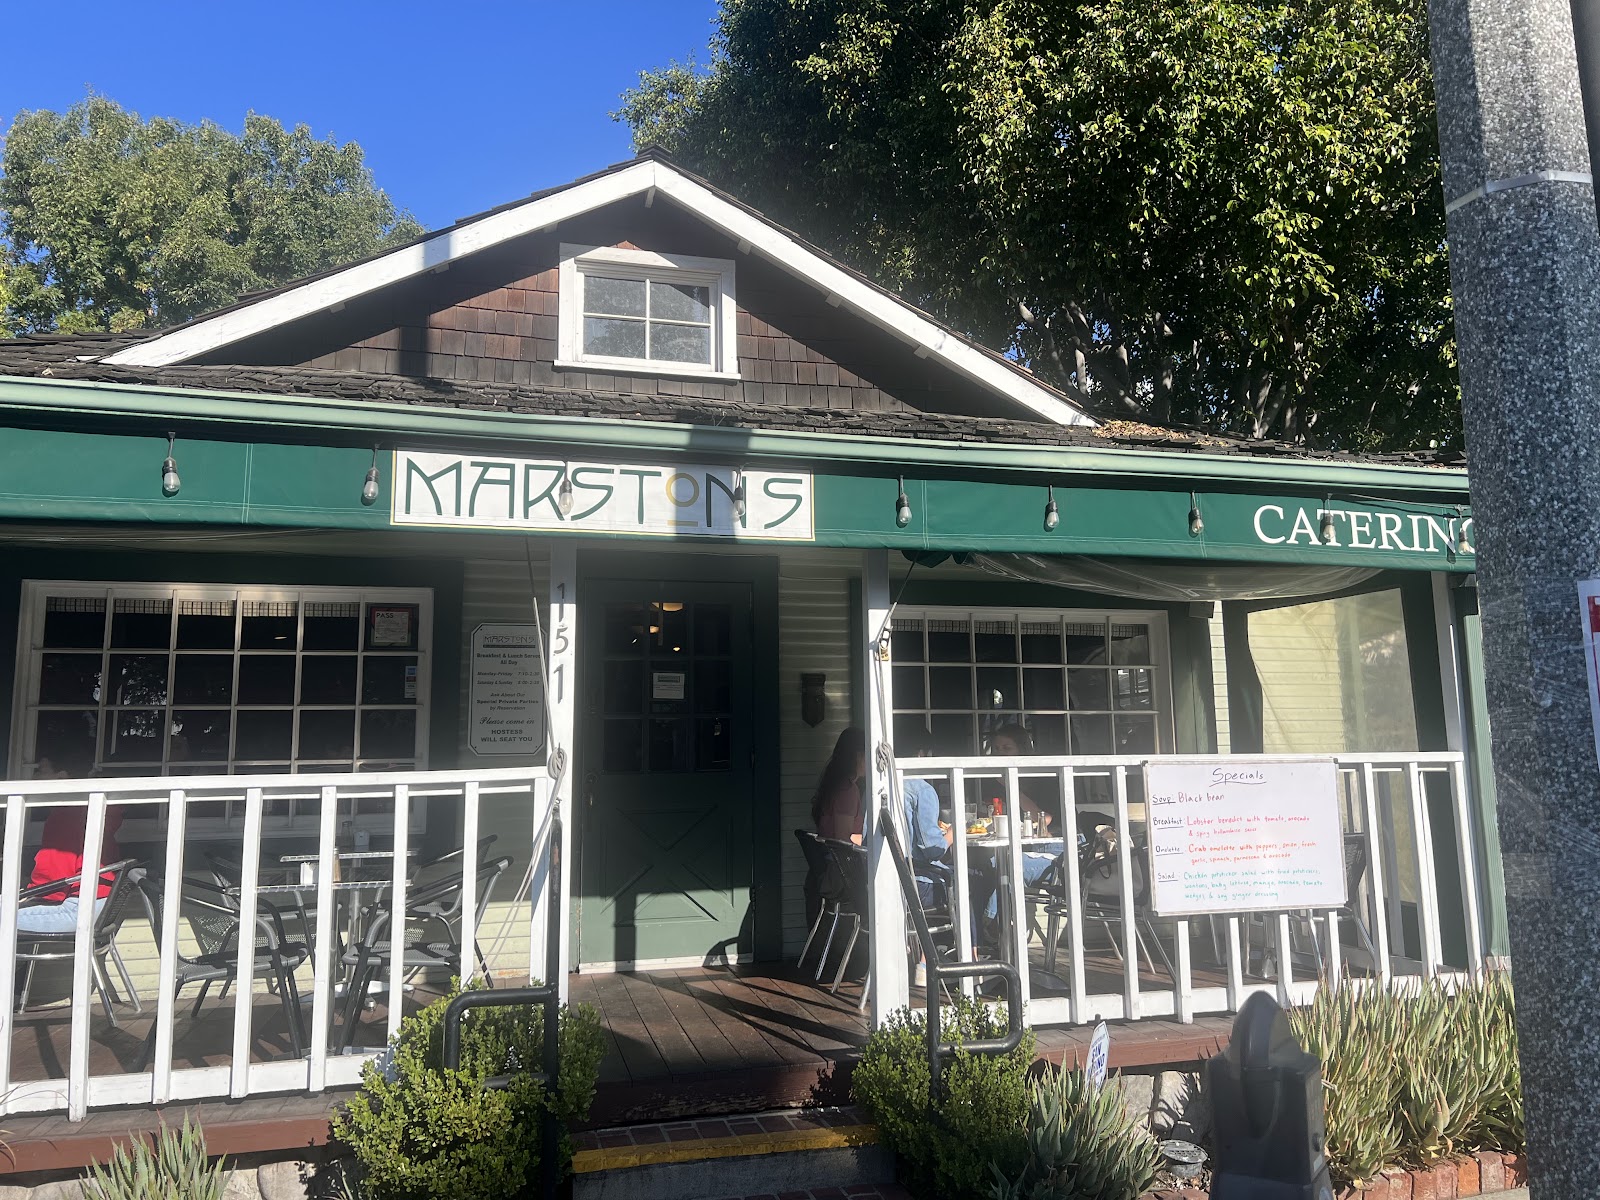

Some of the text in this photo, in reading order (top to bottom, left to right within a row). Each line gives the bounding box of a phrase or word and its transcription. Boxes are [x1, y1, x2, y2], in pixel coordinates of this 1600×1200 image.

[405, 457, 803, 529] MARSTONS
[480, 717, 504, 725] Please
[1212, 768, 1264, 786] Specials
[1178, 791, 1203, 803] Black
[1206, 792, 1225, 802] bean
[1186, 815, 1213, 826] Lobster
[1217, 815, 1243, 823] benedict
[1246, 815, 1260, 823] with
[1188, 843, 1207, 853] Crab
[1209, 844, 1235, 852] omelette
[1239, 843, 1253, 851] with
[1183, 871, 1207, 880] Chicken
[1211, 882, 1227, 890] baby
[1217, 893, 1228, 901] soy
[1231, 891, 1251, 900] ginger
[1254, 891, 1279, 901] dressing
